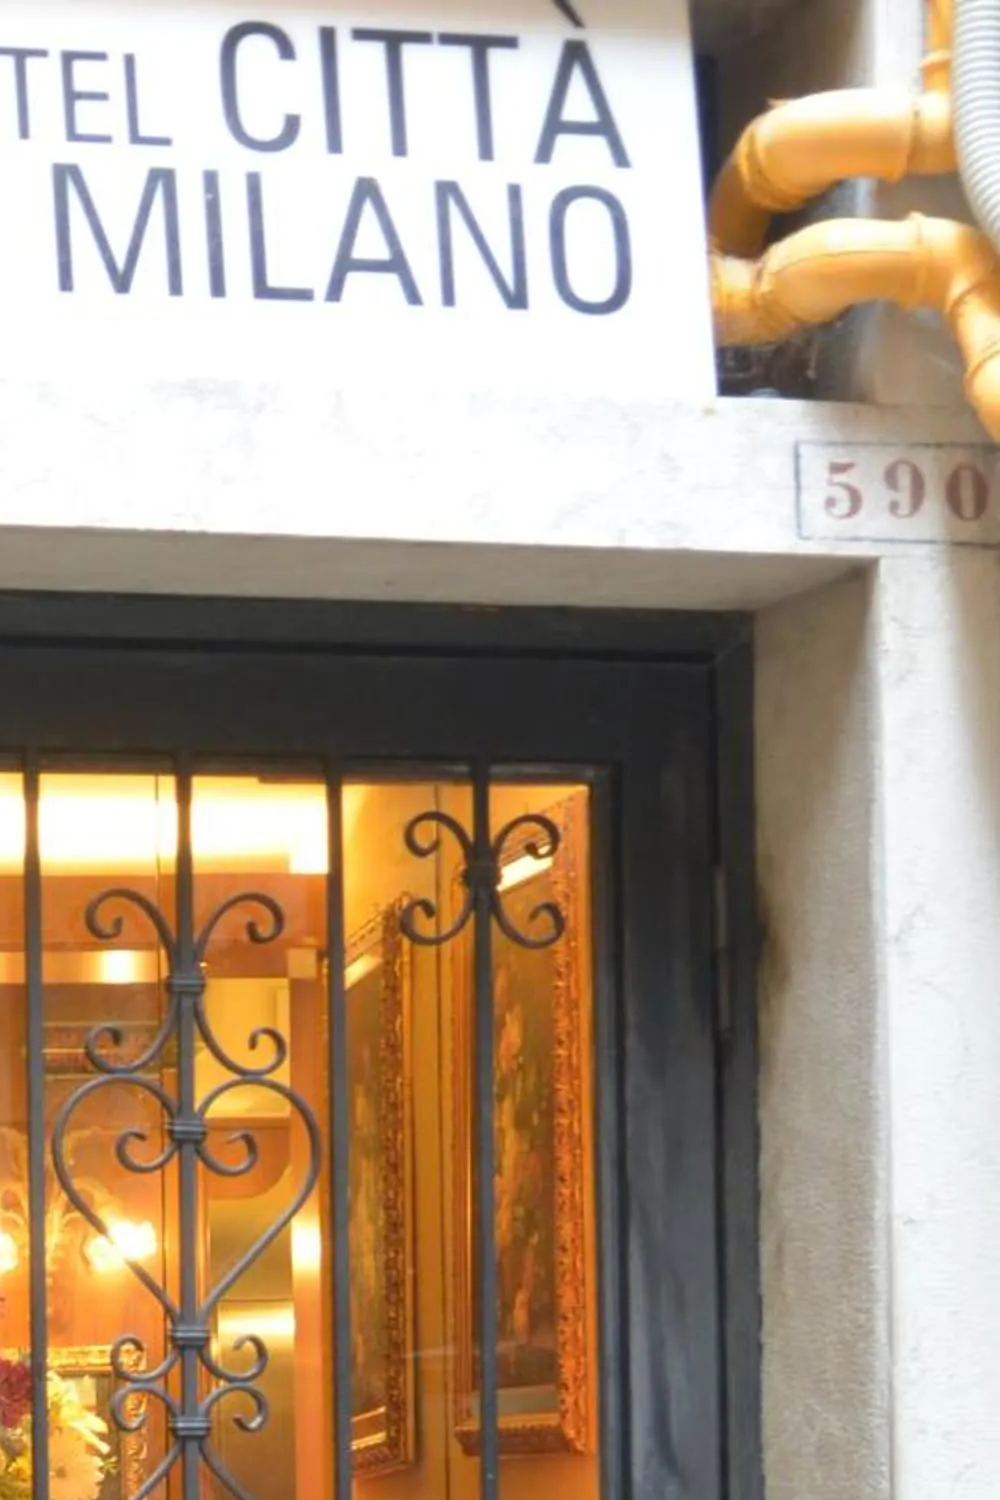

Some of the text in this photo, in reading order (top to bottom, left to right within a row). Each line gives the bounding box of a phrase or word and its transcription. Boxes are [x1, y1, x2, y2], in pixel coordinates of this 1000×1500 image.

[218, 0, 633, 168] CITTÀ
[51, 162, 633, 316] MILANO
[824, 458, 989, 521] 590
